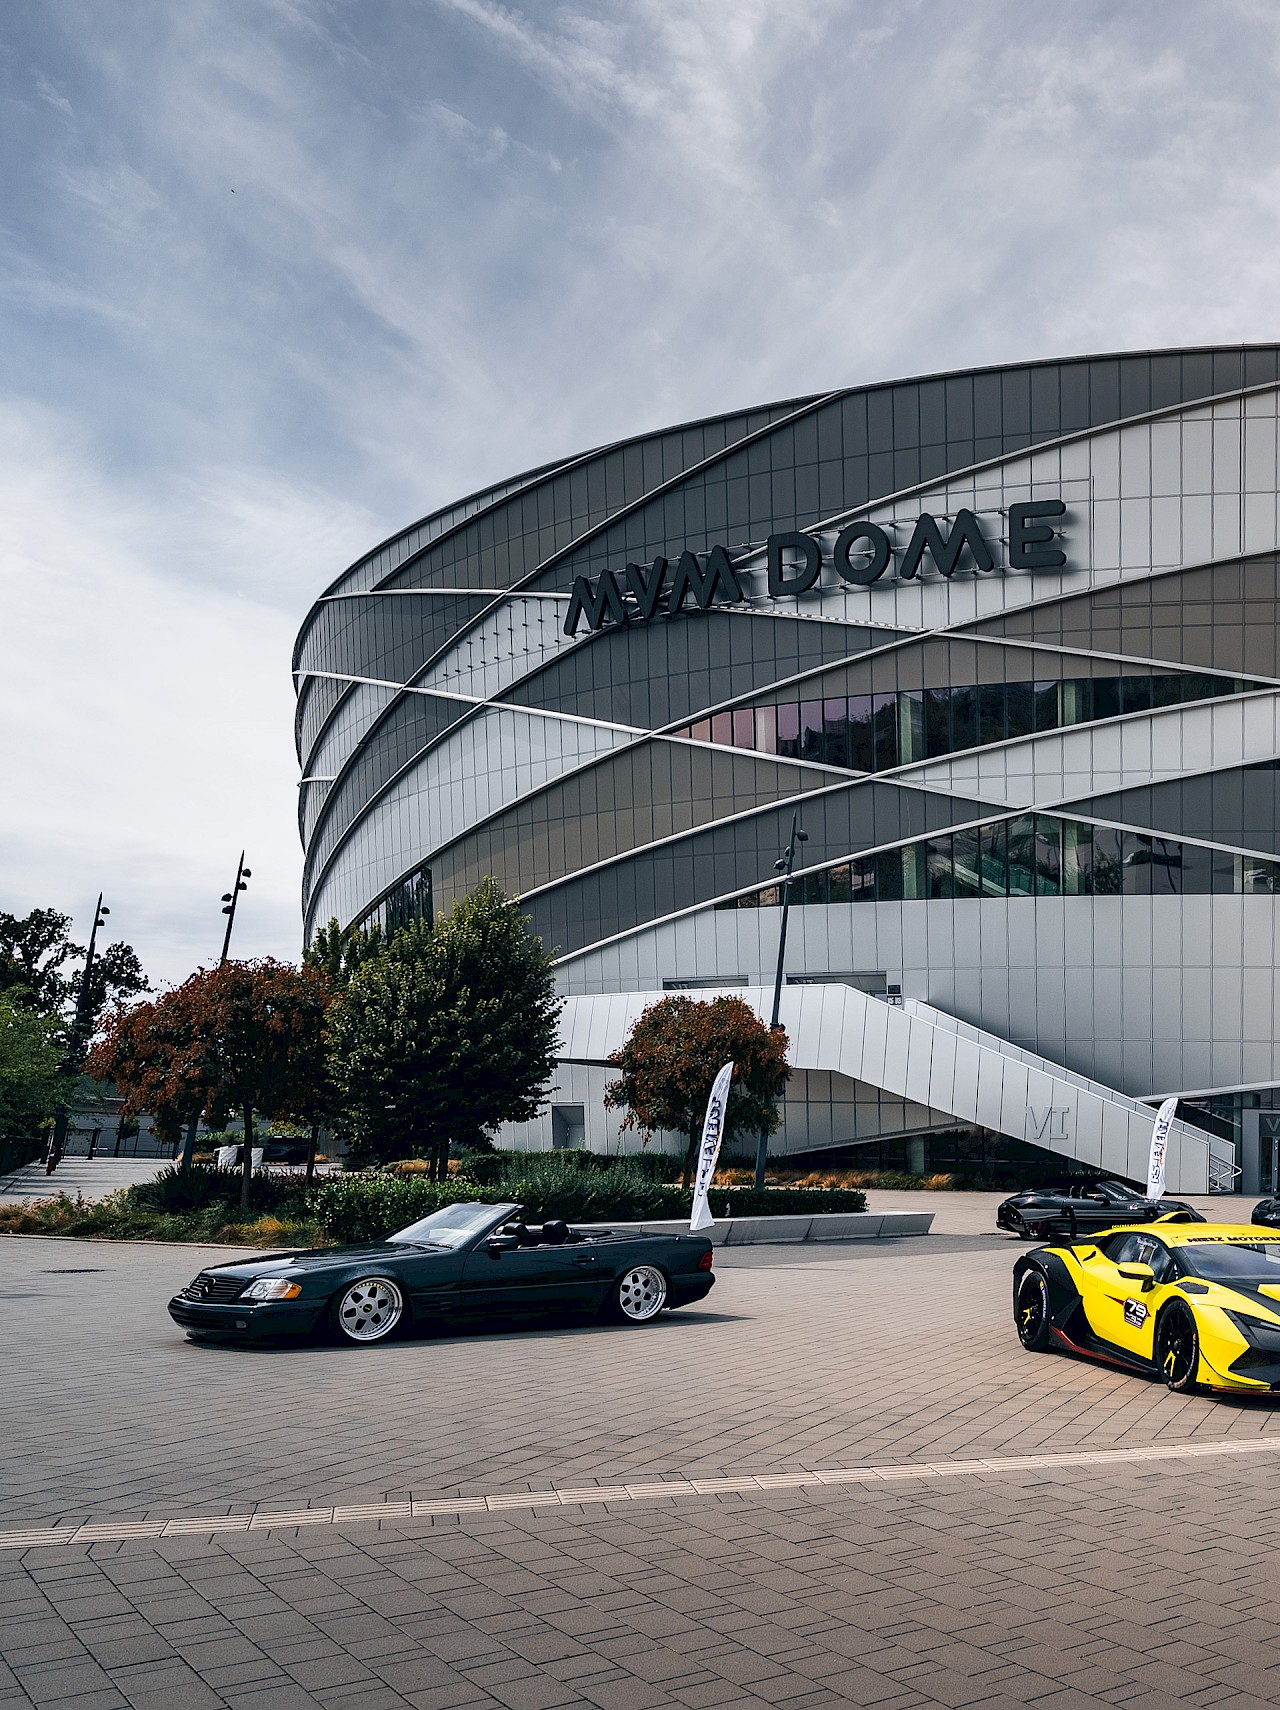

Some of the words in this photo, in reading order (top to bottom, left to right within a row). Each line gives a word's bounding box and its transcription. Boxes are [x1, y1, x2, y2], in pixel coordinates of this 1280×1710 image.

[563, 545, 744, 636] MVM
[767, 500, 1067, 597] DOME
[1024, 1106, 1070, 1140] VI
[1265, 1118, 1280, 1132] V
[1126, 1299, 1147, 1319] 79
